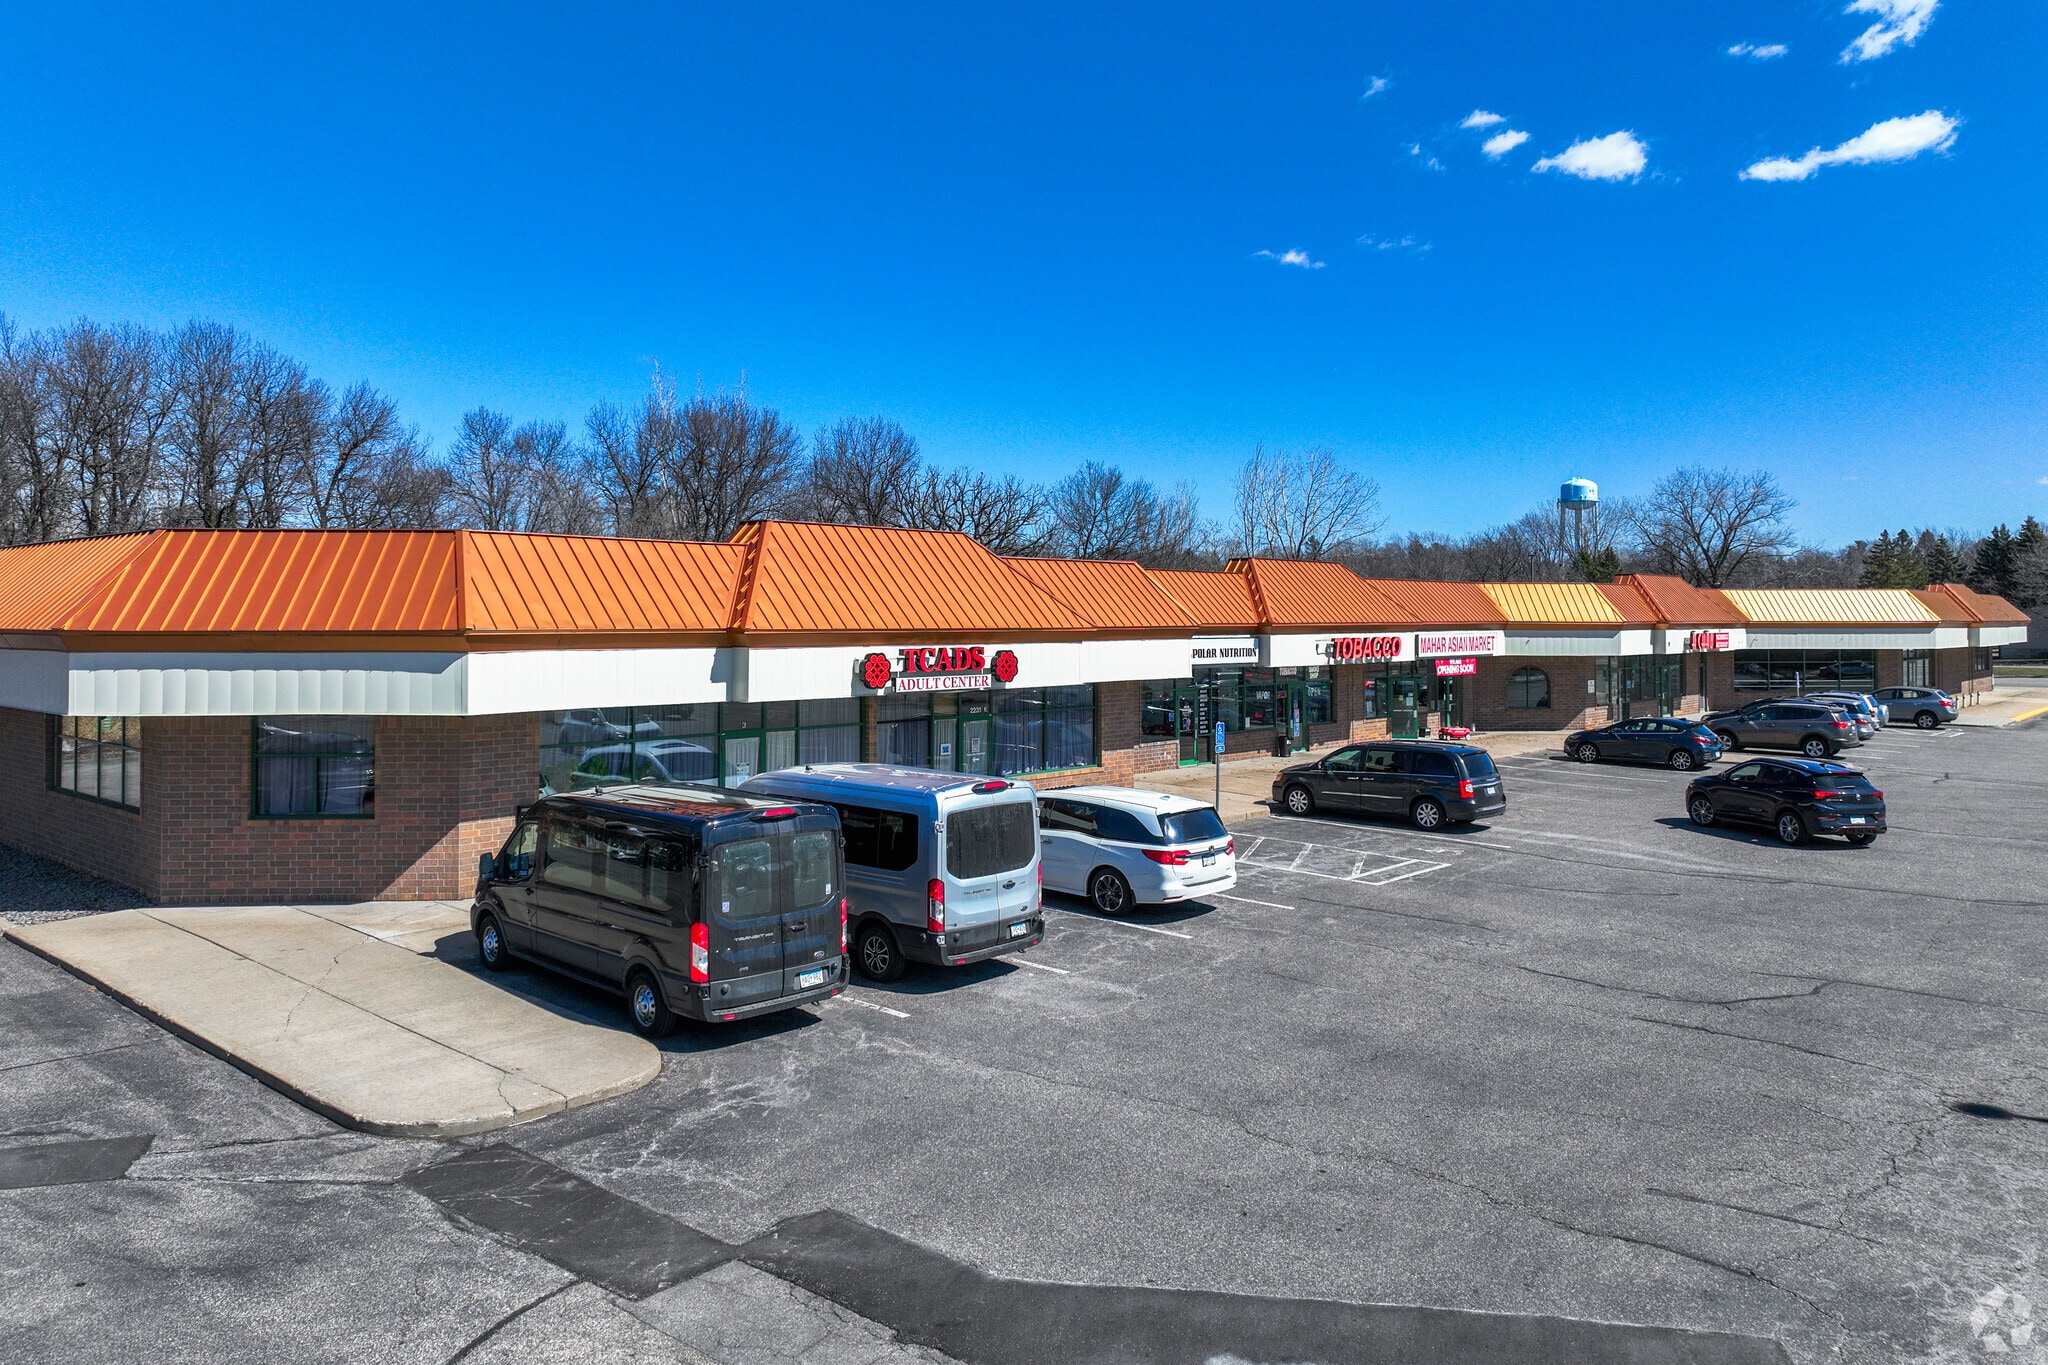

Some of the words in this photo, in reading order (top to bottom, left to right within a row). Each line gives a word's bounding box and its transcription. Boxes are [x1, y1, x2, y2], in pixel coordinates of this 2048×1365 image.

[1334, 636, 1402, 660] TOBACCO
[1420, 636, 1447, 653] MAHAR
[1447, 636, 1468, 652] ASIAN
[1468, 635, 1495, 651] MARKET
[902, 646, 986, 673] TCADS
[1192, 648, 1217, 659] POLAR
[1219, 647, 1257, 658] NUTRITION
[1437, 664, 1459, 675] OPENING
[1459, 663, 1474, 673] SOON
[898, 677, 940, 691] ADULT
[942, 675, 989, 689] CENTER
[969, 706, 982, 714] 2231
